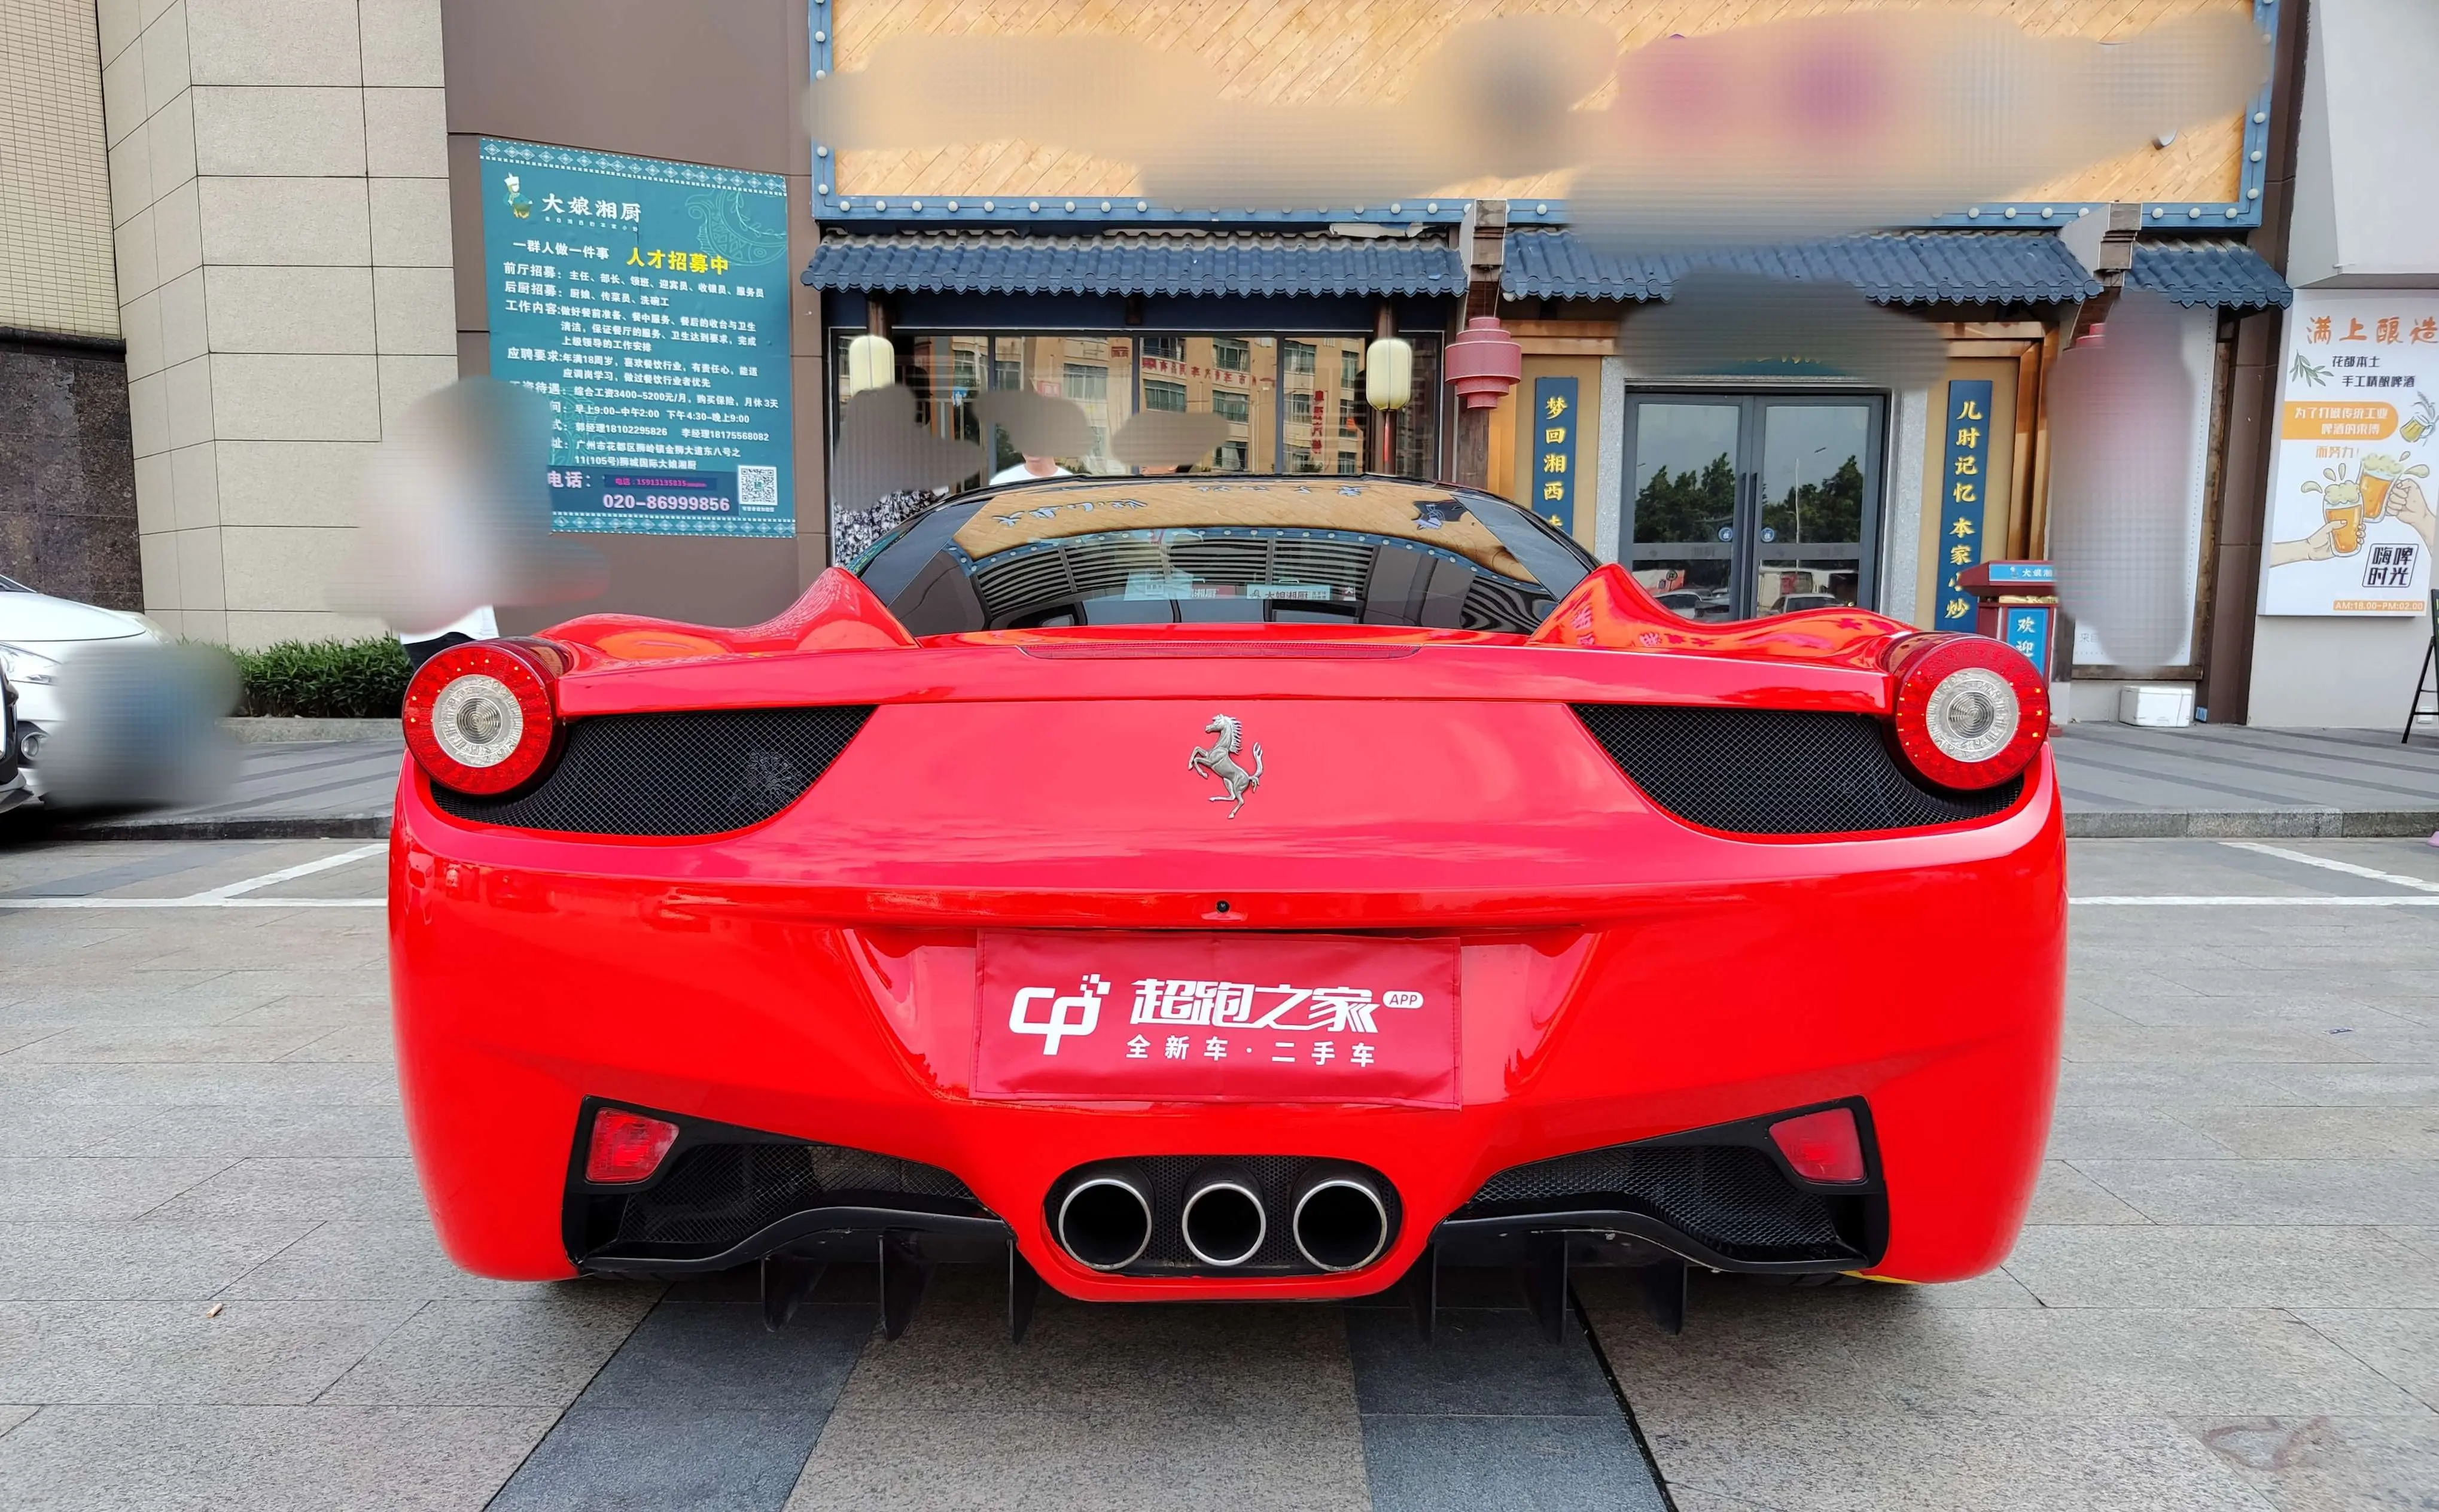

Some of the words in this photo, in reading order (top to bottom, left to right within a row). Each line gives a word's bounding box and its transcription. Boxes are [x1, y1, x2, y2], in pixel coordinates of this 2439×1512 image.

[542, 193, 642, 223] 大娘湘厨
[513, 240, 609, 260] 一群人做一件事
[627, 247, 728, 275] 人才招募中
[2306, 315, 2438, 345] 满上酿造
[561, 336, 651, 352] 上级领导的工作安排
[2332, 355, 2380, 368] 花都本土
[2341, 374, 2416, 388] 手工精酿啤酒
[603, 494, 730, 511] 020-86999856
[2367, 568, 2409, 586] 时光
[2015, 616, 2036, 657] 欢迎
[1129, 978, 1380, 1034] 超跑之家
[1389, 993, 1418, 1007] APP
